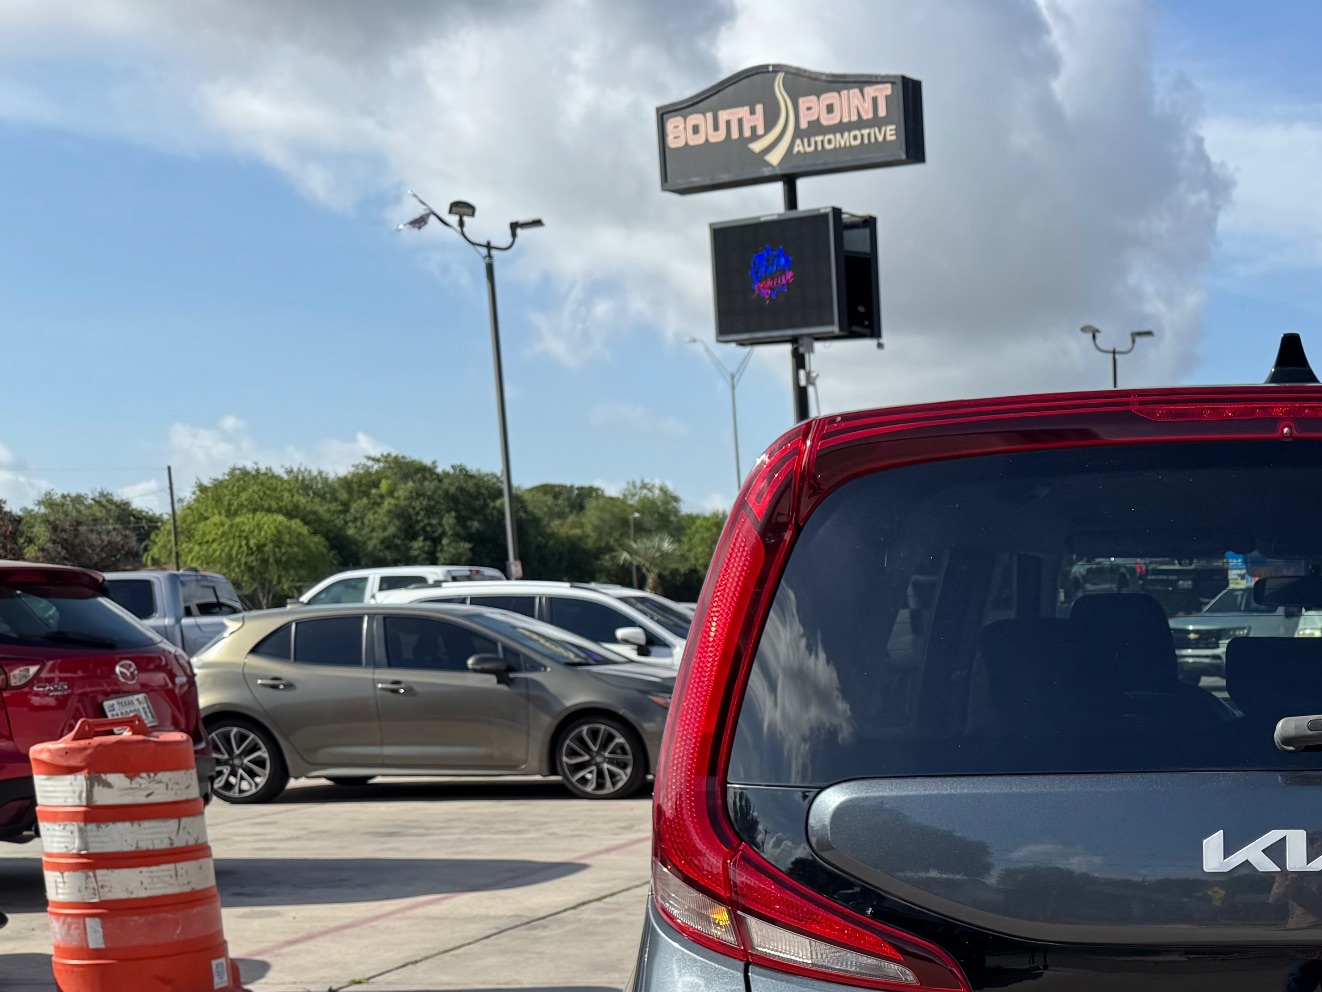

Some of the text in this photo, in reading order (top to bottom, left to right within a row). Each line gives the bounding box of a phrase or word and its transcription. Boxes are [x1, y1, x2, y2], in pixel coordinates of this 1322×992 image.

[665, 83, 892, 149] SOUTH POINT
[792, 124, 897, 155] AUTOMOTIVE
